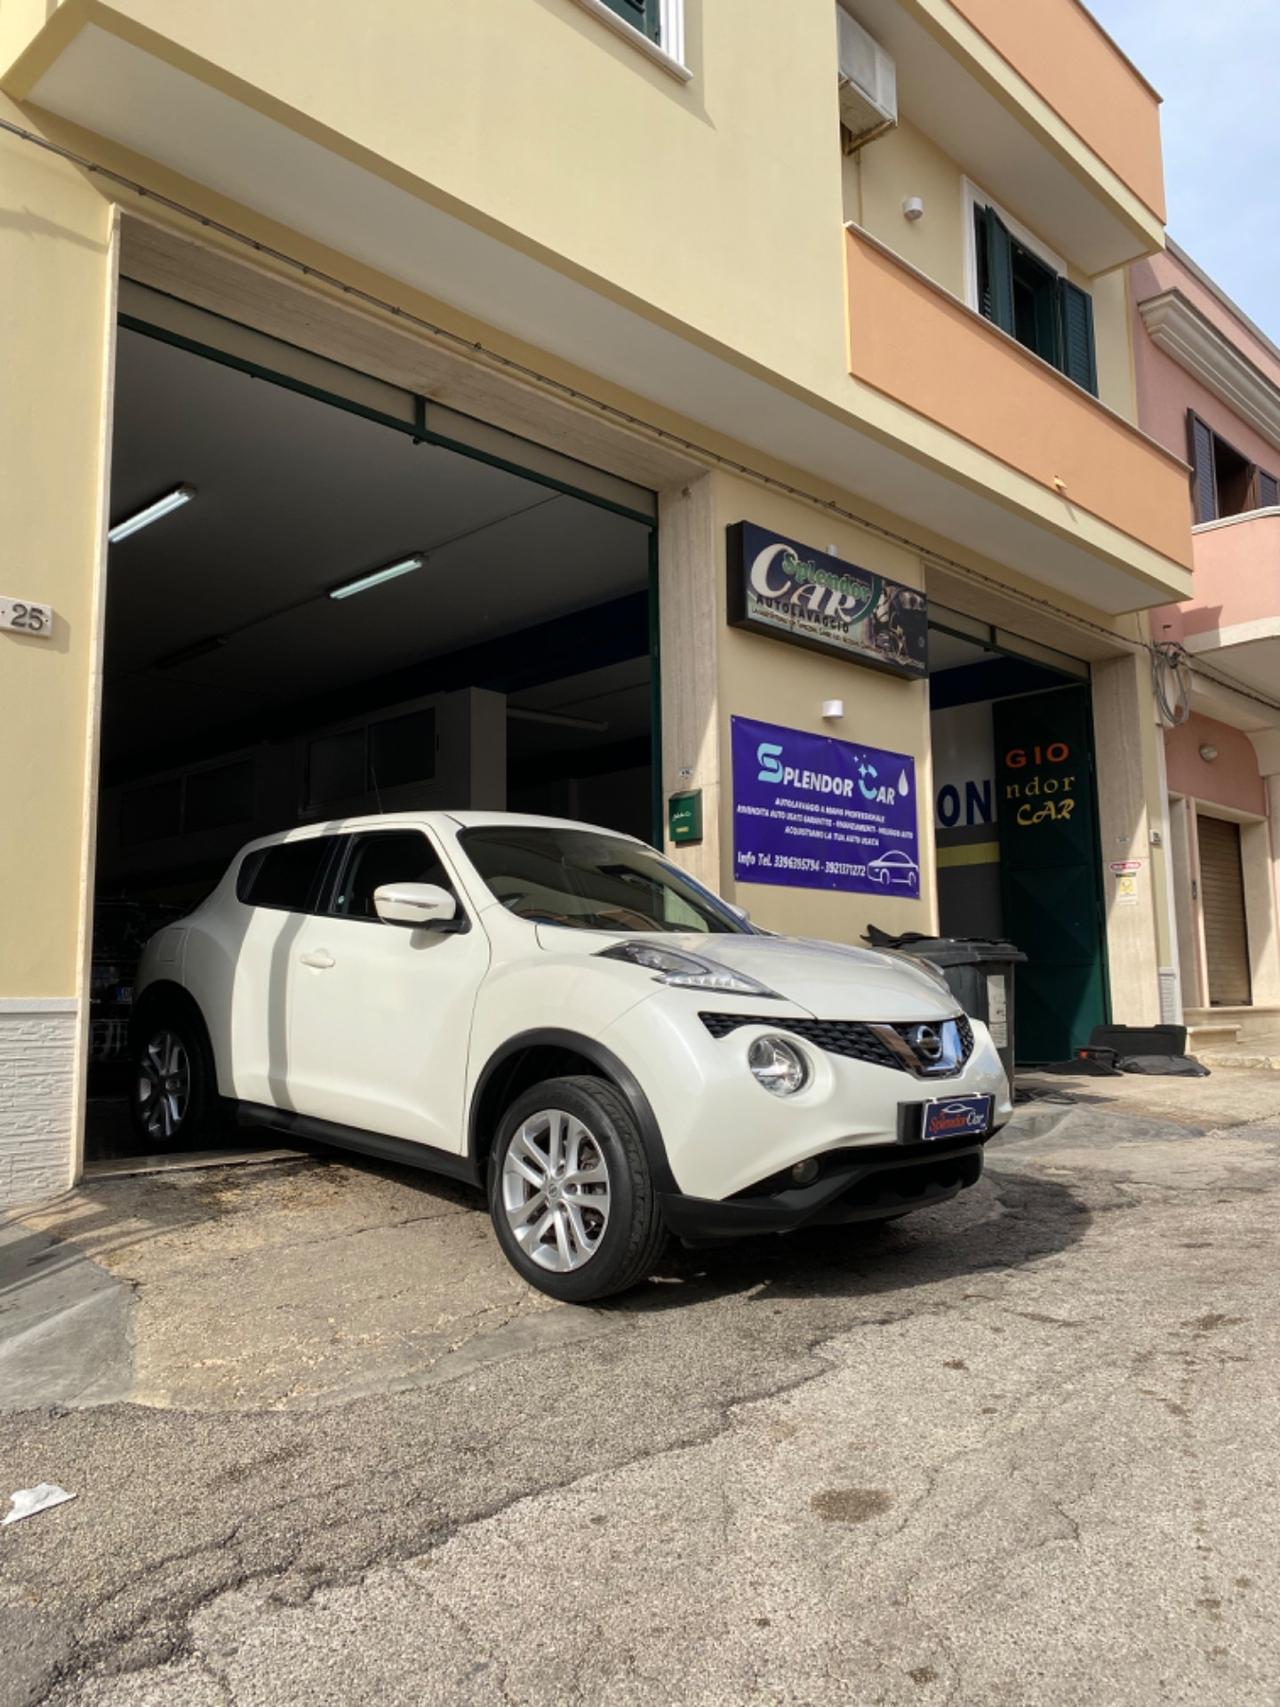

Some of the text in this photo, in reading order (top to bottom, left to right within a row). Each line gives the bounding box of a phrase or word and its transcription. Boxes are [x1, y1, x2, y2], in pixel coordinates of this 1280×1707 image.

[782, 551, 872, 602] Splendor
[11, 603, 43, 631] 25
[756, 597, 849, 634] AUTOLAVAGGIO
[1005, 743, 1069, 768] GIO
[757, 743, 854, 797] SPLENDOR
[1006, 776, 1075, 799] ndor
[738, 851, 756, 867] Info
